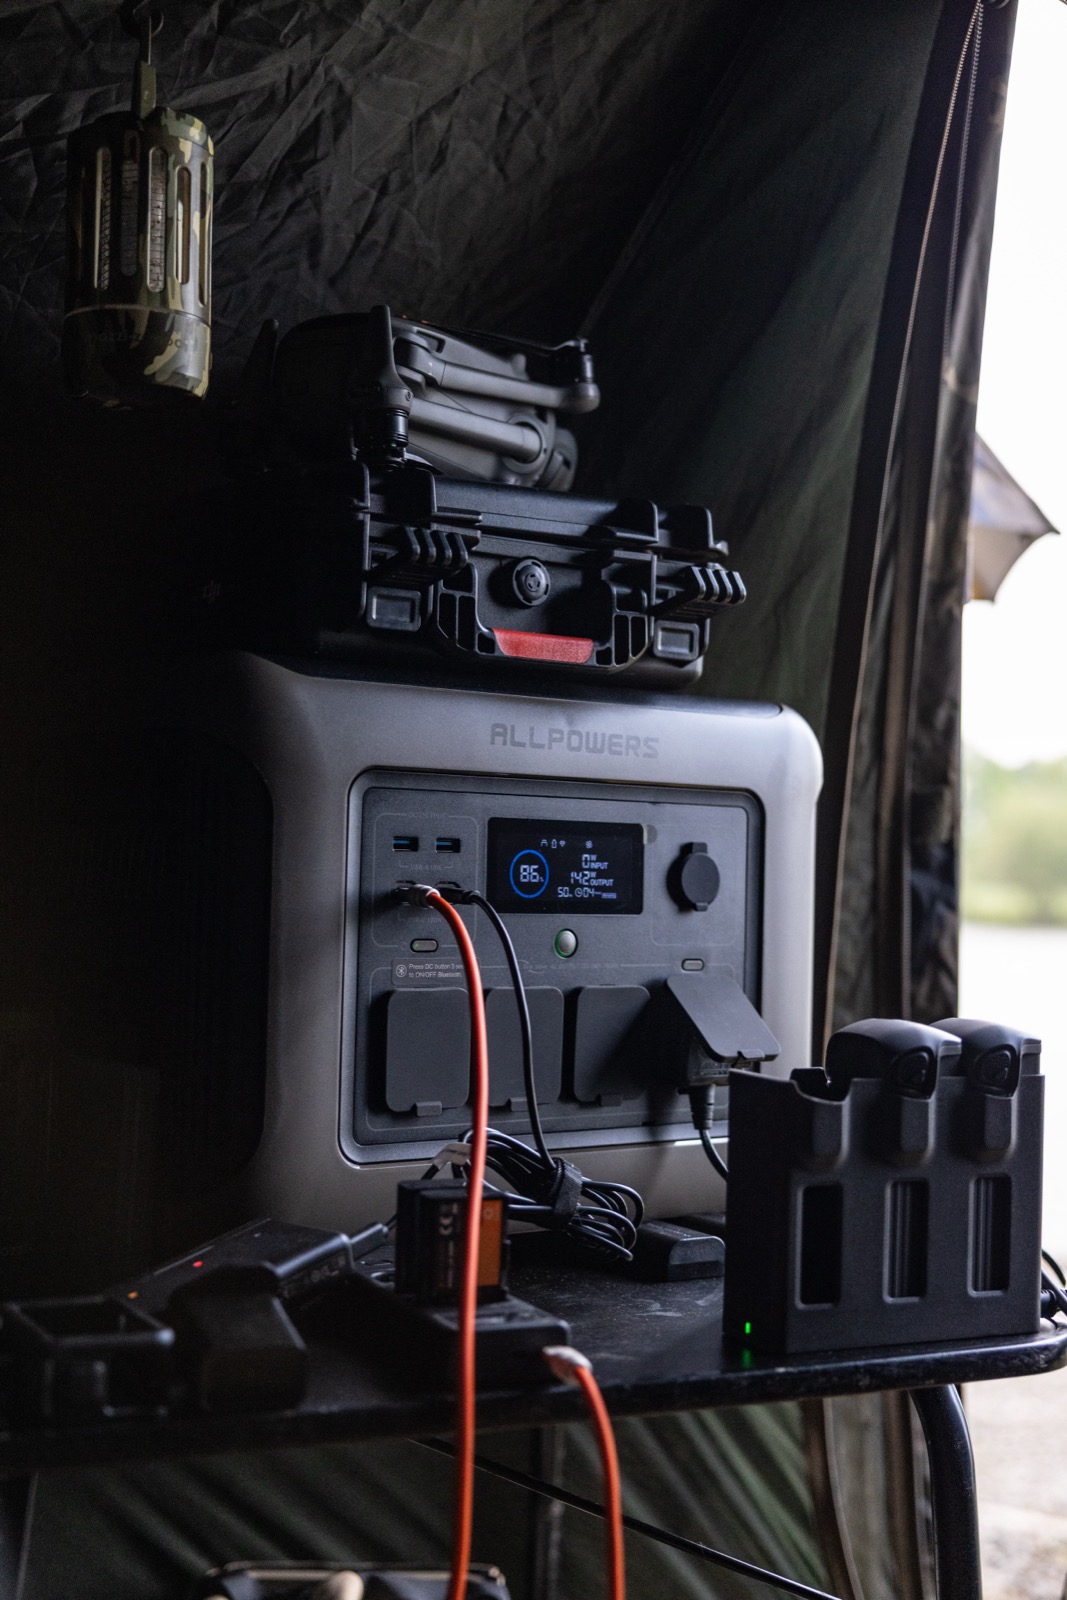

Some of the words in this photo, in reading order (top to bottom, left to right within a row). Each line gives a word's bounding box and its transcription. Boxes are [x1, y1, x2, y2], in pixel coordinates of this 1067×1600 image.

[490, 722, 661, 760] ALLPOWERS
[590, 861, 609, 870] INPUT
[590, 878, 614, 887] OUTPUT
